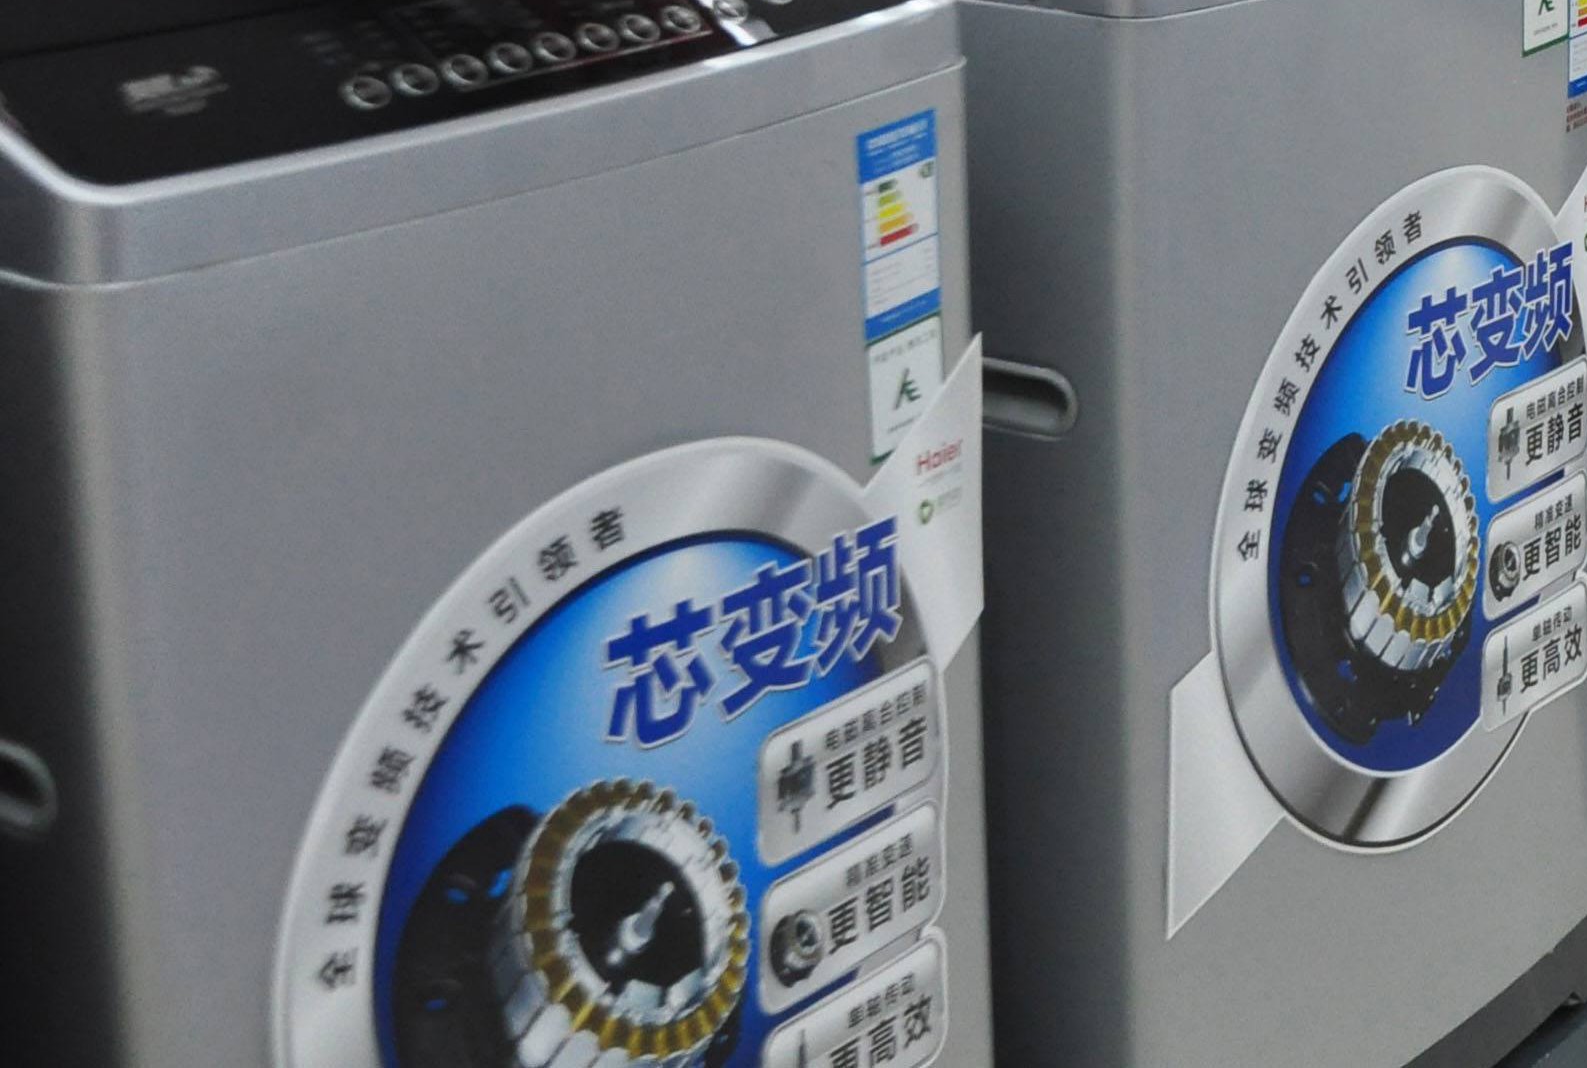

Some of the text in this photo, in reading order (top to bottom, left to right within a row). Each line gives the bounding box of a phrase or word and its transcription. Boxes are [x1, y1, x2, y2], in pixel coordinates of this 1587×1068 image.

[1405, 241, 1573, 399] 芯变频
[1237, 210, 1424, 562] 全球变频技术引领者
[1526, 402, 1584, 466] 更静音
[916, 439, 964, 475] Haier
[1523, 513, 1582, 582] 更智能
[605, 515, 902, 748] 芯变频
[1520, 623, 1583, 695] 更高效
[313, 505, 626, 993] 全球变频技术引领者
[825, 715, 928, 810] 更静音
[828, 856, 931, 955] 更智能
